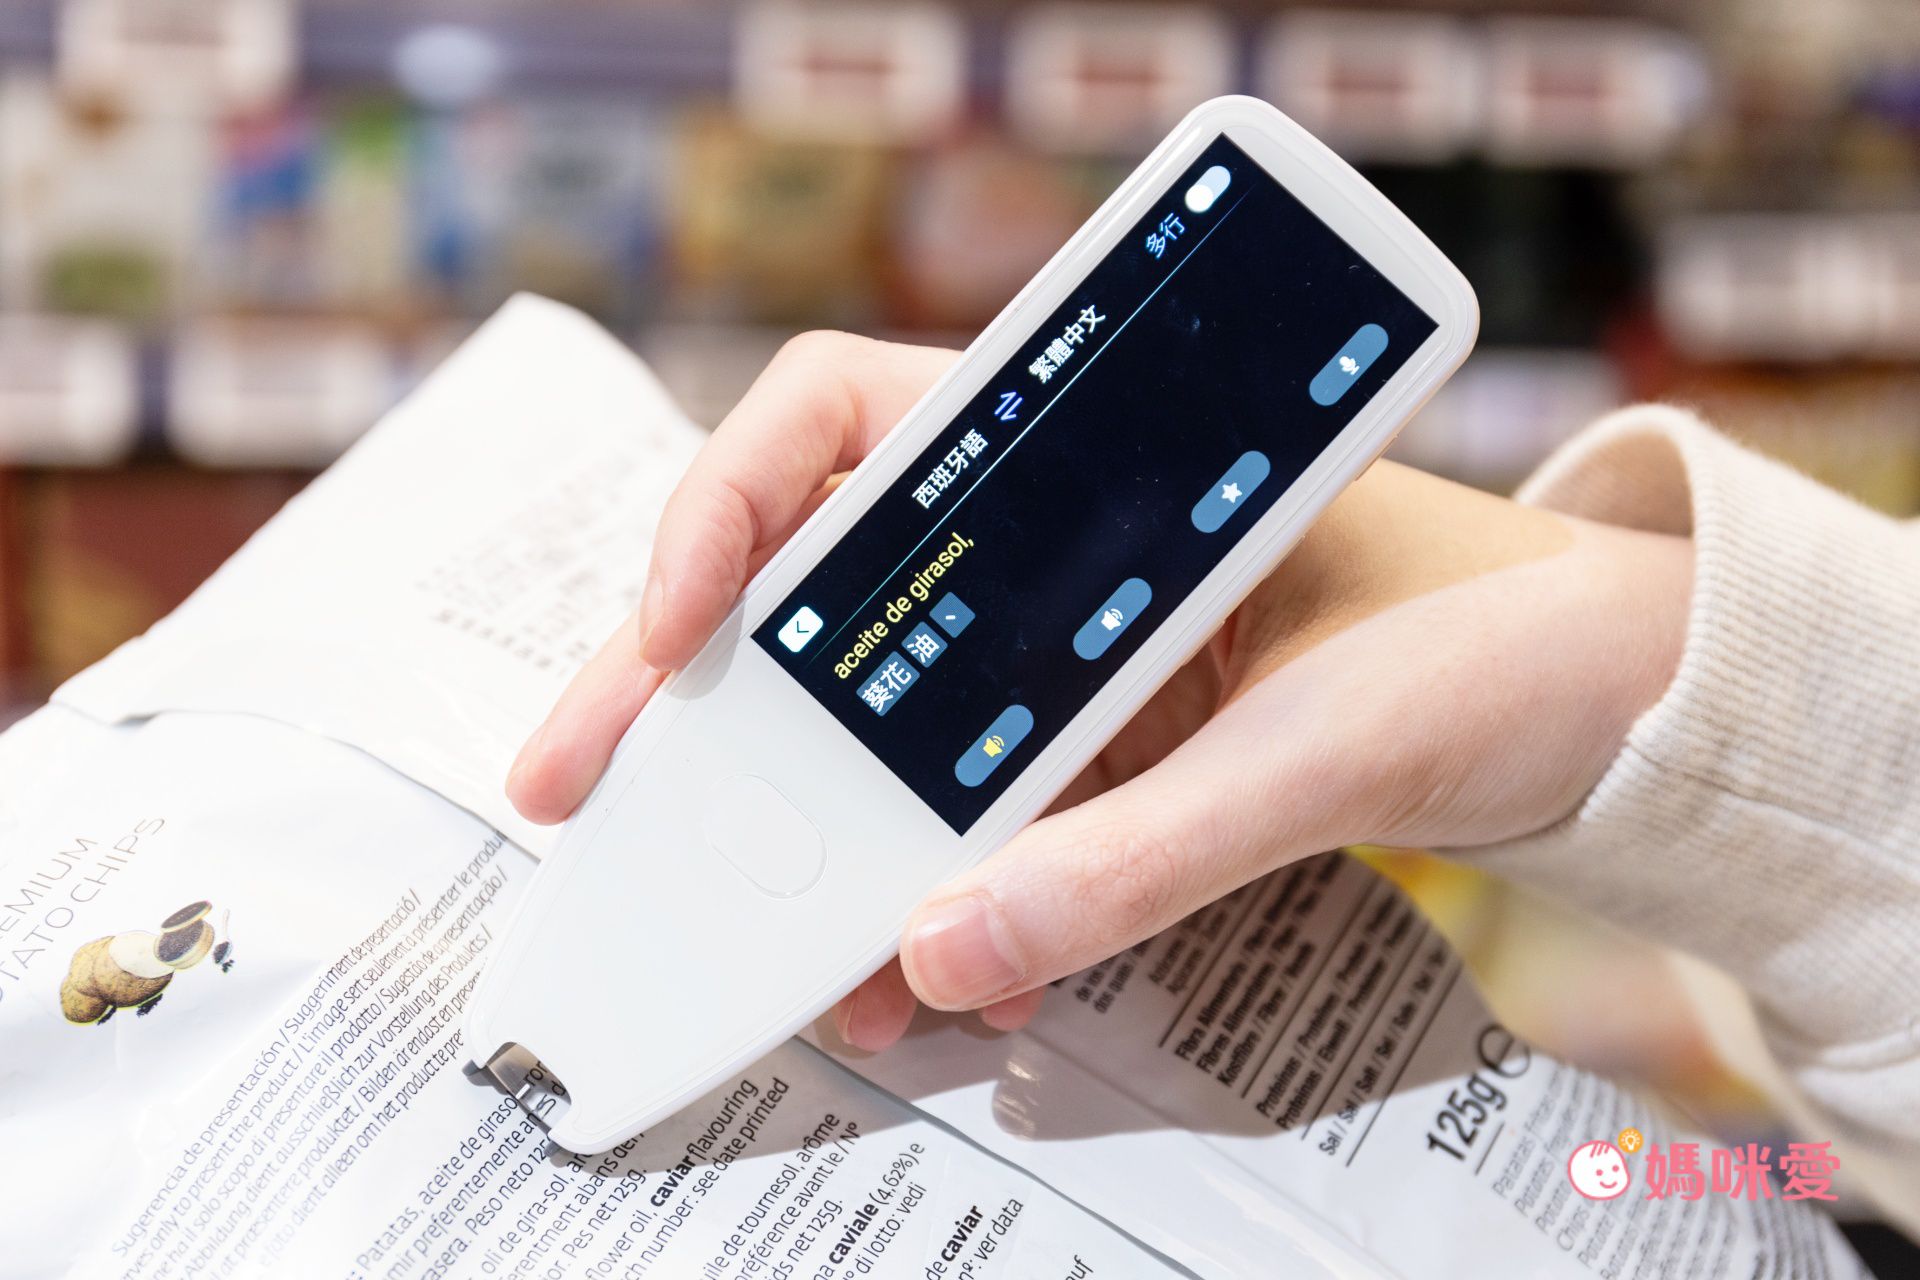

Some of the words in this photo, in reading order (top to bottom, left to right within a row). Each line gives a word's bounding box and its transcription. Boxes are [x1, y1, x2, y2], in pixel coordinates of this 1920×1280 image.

[1145, 213, 1186, 259] 多行
[911, 428, 988, 509] 西班牙語
[1028, 304, 1106, 385] 繁體中文
[833, 621, 889, 680] aceite
[885, 596, 913, 624] de
[909, 535, 976, 602] girasol,
[0, 838, 98, 932] EMIUM
[70, 818, 165, 903] CHIPS
[112, 1165, 188, 1257] Sugerencia
[183, 1142, 205, 1165] de
[200, 1041, 286, 1146] presentación
[284, 954, 358, 1034] Suggeriment
[349, 946, 368, 961] de
[360, 896, 416, 955] presentació
[150, 1214, 180, 1250] only
[172, 1196, 192, 1216] to
[187, 1141, 235, 1202] present
[228, 1115, 255, 1143] the
[249, 1058, 299, 1121] product
[343, 979, 369, 1005] sert
[362, 941, 412, 986] seulement
[411, 882, 461, 943] présenter
[454, 871, 472, 888] le
[165, 1240, 190, 1263] ha
[184, 1227, 198, 1242] il
[193, 1197, 222, 1231] solo
[217, 1153, 255, 1200] scopo
[251, 1135, 267, 1156] di
[263, 1062, 327, 1143] presentare
[318, 1050, 335, 1067] il
[330, 1003, 382, 1060] prodotto
[379, 960, 428, 1004] Sugestão
[422, 950, 439, 965] de
[433, 875, 502, 955] apresentação
[1173, 1023, 1208, 1062] Fibra
[1194, 1029, 1234, 1075] Fibres
[185, 1200, 252, 1278] Abbildung
[245, 1161, 280, 1203] dient
[277, 1065, 361, 1164] ausschließlich
[354, 1043, 378, 1071] zur
[369, 990, 436, 1054] Vorstellung
[427, 974, 449, 996] des
[440, 934, 488, 980] Produkts
[292, 1184, 328, 1226] dient
[323, 1144, 361, 1189] alleen
[356, 1122, 381, 1148] om
[372, 1100, 401, 1127] het
[395, 1059, 440, 1110] product
[432, 1049, 449, 1066] te
[297, 1105, 360, 1178] produktet
[358, 1061, 400, 1103] Bilden
[393, 1048, 411, 1067] är
[407, 1015, 445, 1055] endast
[439, 1004, 456, 1022] en
[1317, 1129, 1345, 1157] Sal
[1336, 1098, 1363, 1125] Sal
[1425, 1068, 1509, 1162] 125g
[464, 1197, 503, 1235] Peso
[498, 1162, 534, 1199] neto
[574, 1157, 618, 1205] abans
[630, 1209, 658, 1233] oil,
[650, 1155, 696, 1207] caviar
[686, 1079, 759, 1161] flavouring
[640, 1195, 699, 1263] number:
[692, 1170, 720, 1197] see
[712, 1138, 747, 1171] date
[739, 1077, 789, 1142] printed
[722, 1234, 746, 1256] de
[737, 1163, 805, 1234] tournesol,
[796, 1114, 840, 1163] arôme
[794, 1165, 834, 1208] avant
[821, 1152, 844, 1167] le
[896, 1182, 927, 1214] vedi
[356, 1206, 425, 1271] Patatas,
[419, 1156, 464, 1205] aceite
[460, 1137, 482, 1159] de
[387, 1249, 416, 1279] mir
[413, 1130, 526, 1254] preferentemente
[481, 1248, 504, 1274] oli
[499, 1231, 522, 1253] de
[516, 1173, 575, 1236] gira-sol,
[562, 1229, 594, 1258] Pes
[588, 1201, 617, 1231] net
[608, 1169, 647, 1203] 125g.
[787, 1232, 816, 1262] net
[806, 1200, 843, 1232] 125g.
[829, 1204, 879, 1264] caviale
[868, 1153, 919, 1205] (4,62%)
[910, 1143, 925, 1154] e
[863, 1214, 904, 1258] lotto:
[941, 1205, 983, 1262] caviar
[974, 1232, 998, 1260] ver
[991, 1199, 1024, 1236] data
[855, 1254, 874, 1274] di
